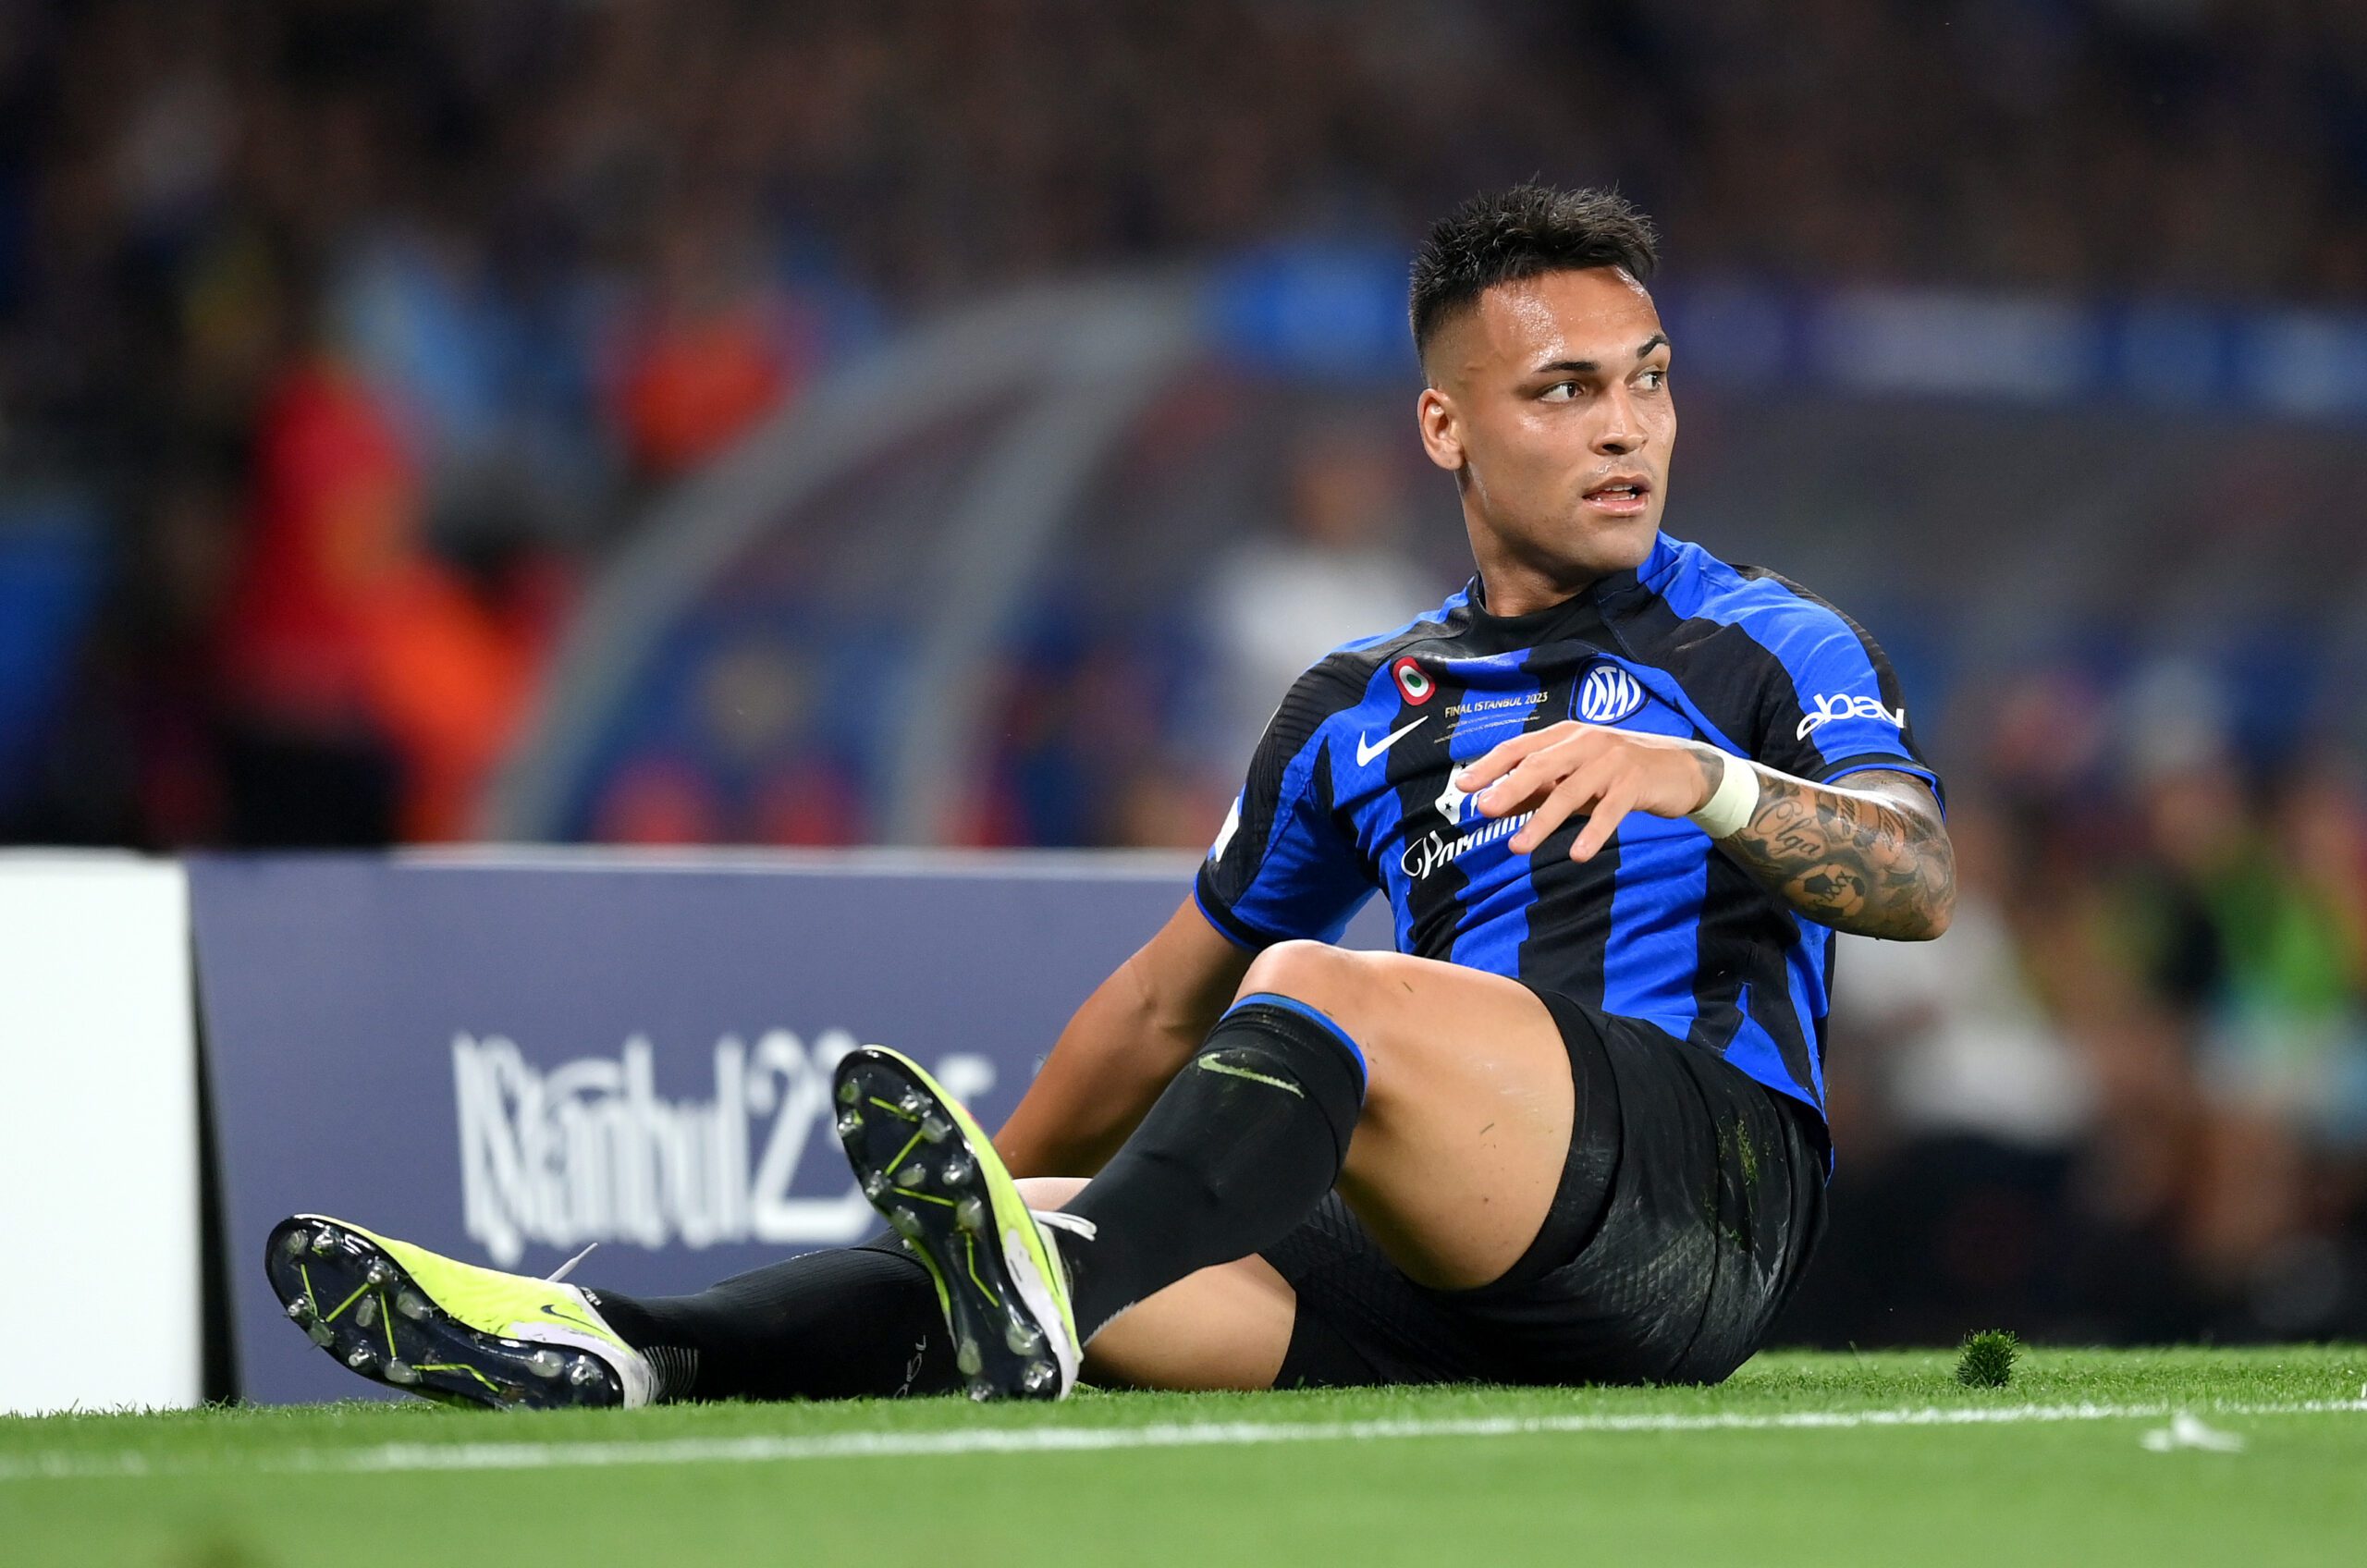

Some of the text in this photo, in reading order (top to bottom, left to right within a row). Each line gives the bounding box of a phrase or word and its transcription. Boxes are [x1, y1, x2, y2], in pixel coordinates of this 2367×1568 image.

[1444, 691, 1549, 718] FINAL ISTANBUL 2023
